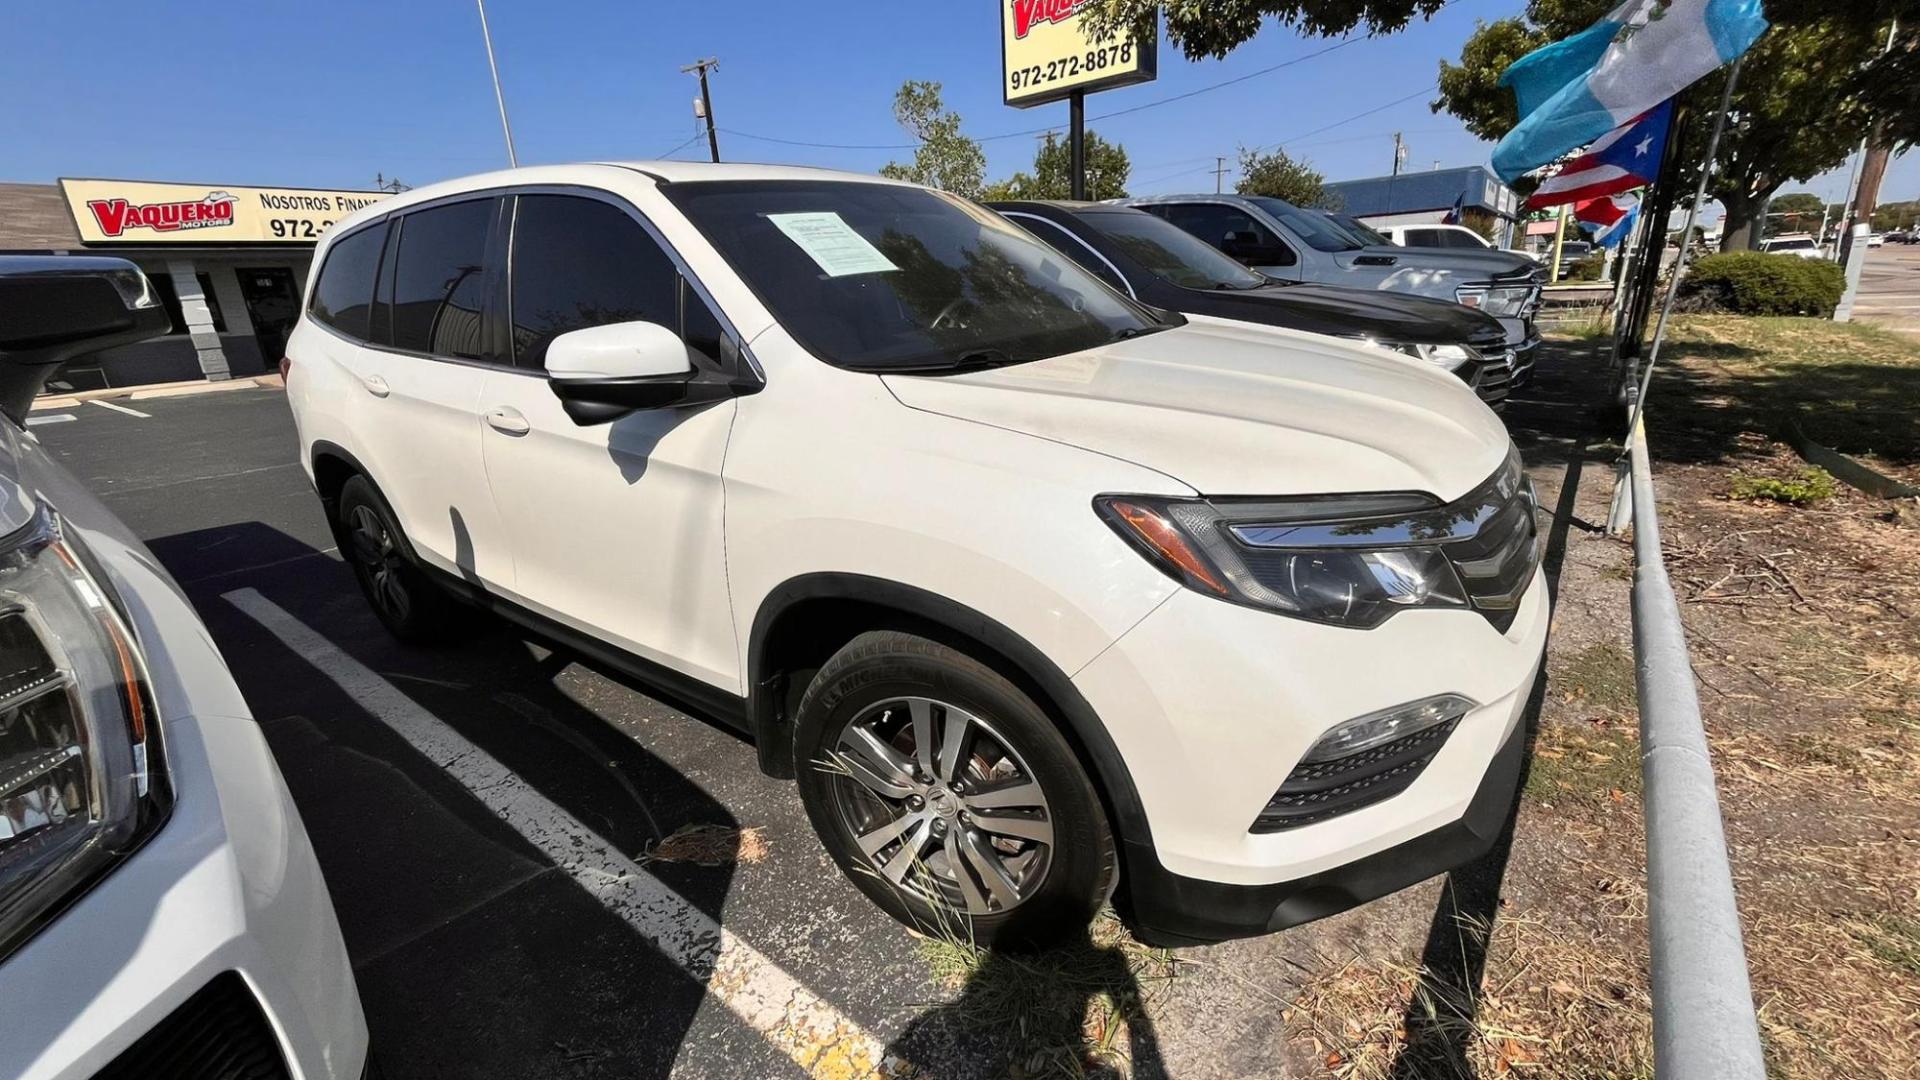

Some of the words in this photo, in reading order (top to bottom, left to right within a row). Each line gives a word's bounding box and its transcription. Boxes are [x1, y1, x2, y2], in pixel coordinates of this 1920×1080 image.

[1011, 42, 1131, 90] 972-272-8878
[260, 193, 331, 211] NOSOTROS
[88, 199, 232, 236] VAQUERO
[182, 218, 231, 229] MOTORS
